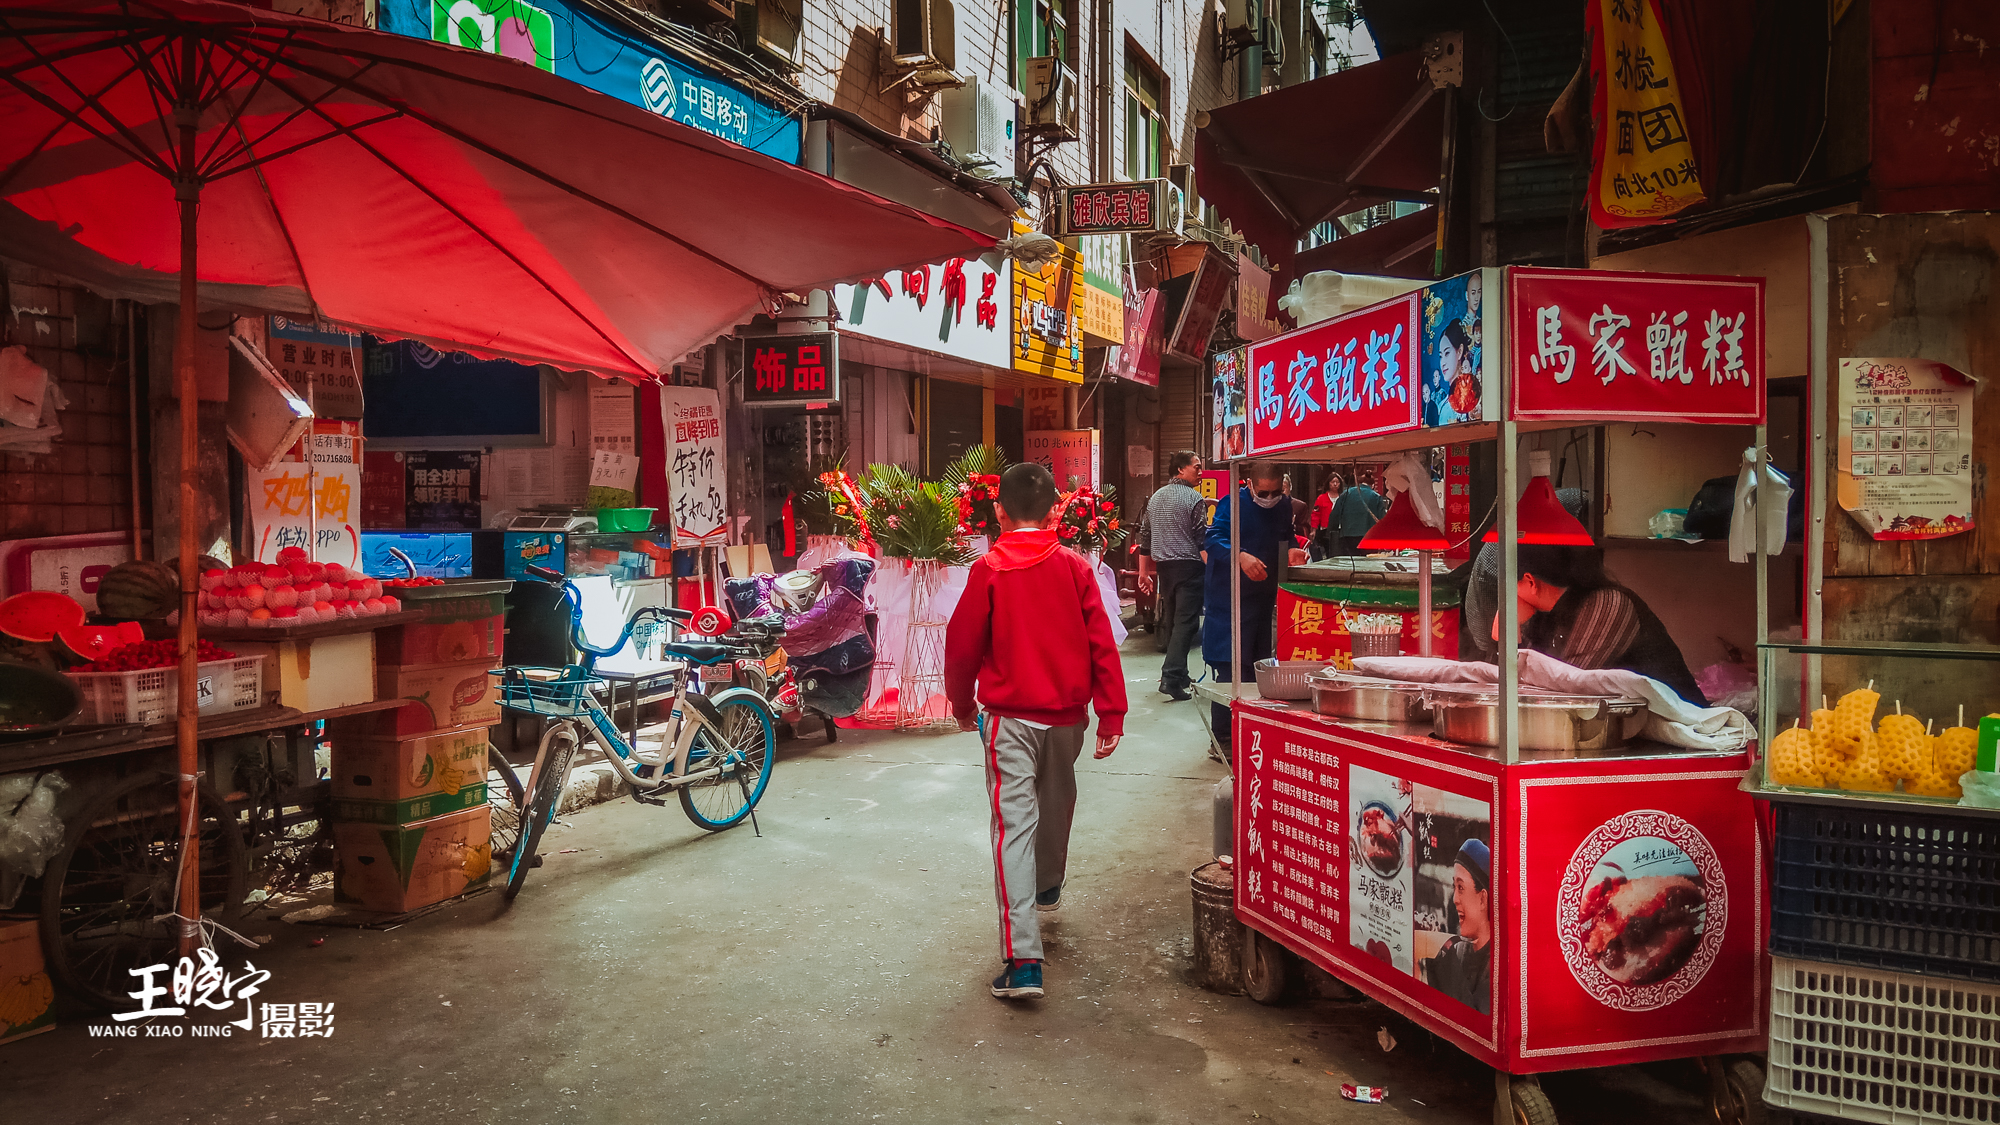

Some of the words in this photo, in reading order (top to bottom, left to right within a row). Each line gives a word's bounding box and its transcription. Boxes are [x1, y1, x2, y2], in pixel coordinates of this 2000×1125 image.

[682, 79, 748, 135] 中国移动
[1613, 158, 1699, 200] 向北10米
[1073, 189, 1150, 227] 雅欣宾馆
[282, 343, 354, 369] 营业时间
[1530, 303, 1750, 387] 馬家甑糕
[752, 346, 826, 393] 饰品
[1254, 323, 1406, 430] 馬家甑糕
[675, 418, 719, 446] 直降到底
[303, 453, 352, 463] 1201716808
[672, 446, 715, 488] 特价
[413, 468, 471, 486] 用全球通
[413, 486, 471, 504] 领好手机
[410, 801, 431, 818] 精品
[464, 788, 482, 805] 香蕉
